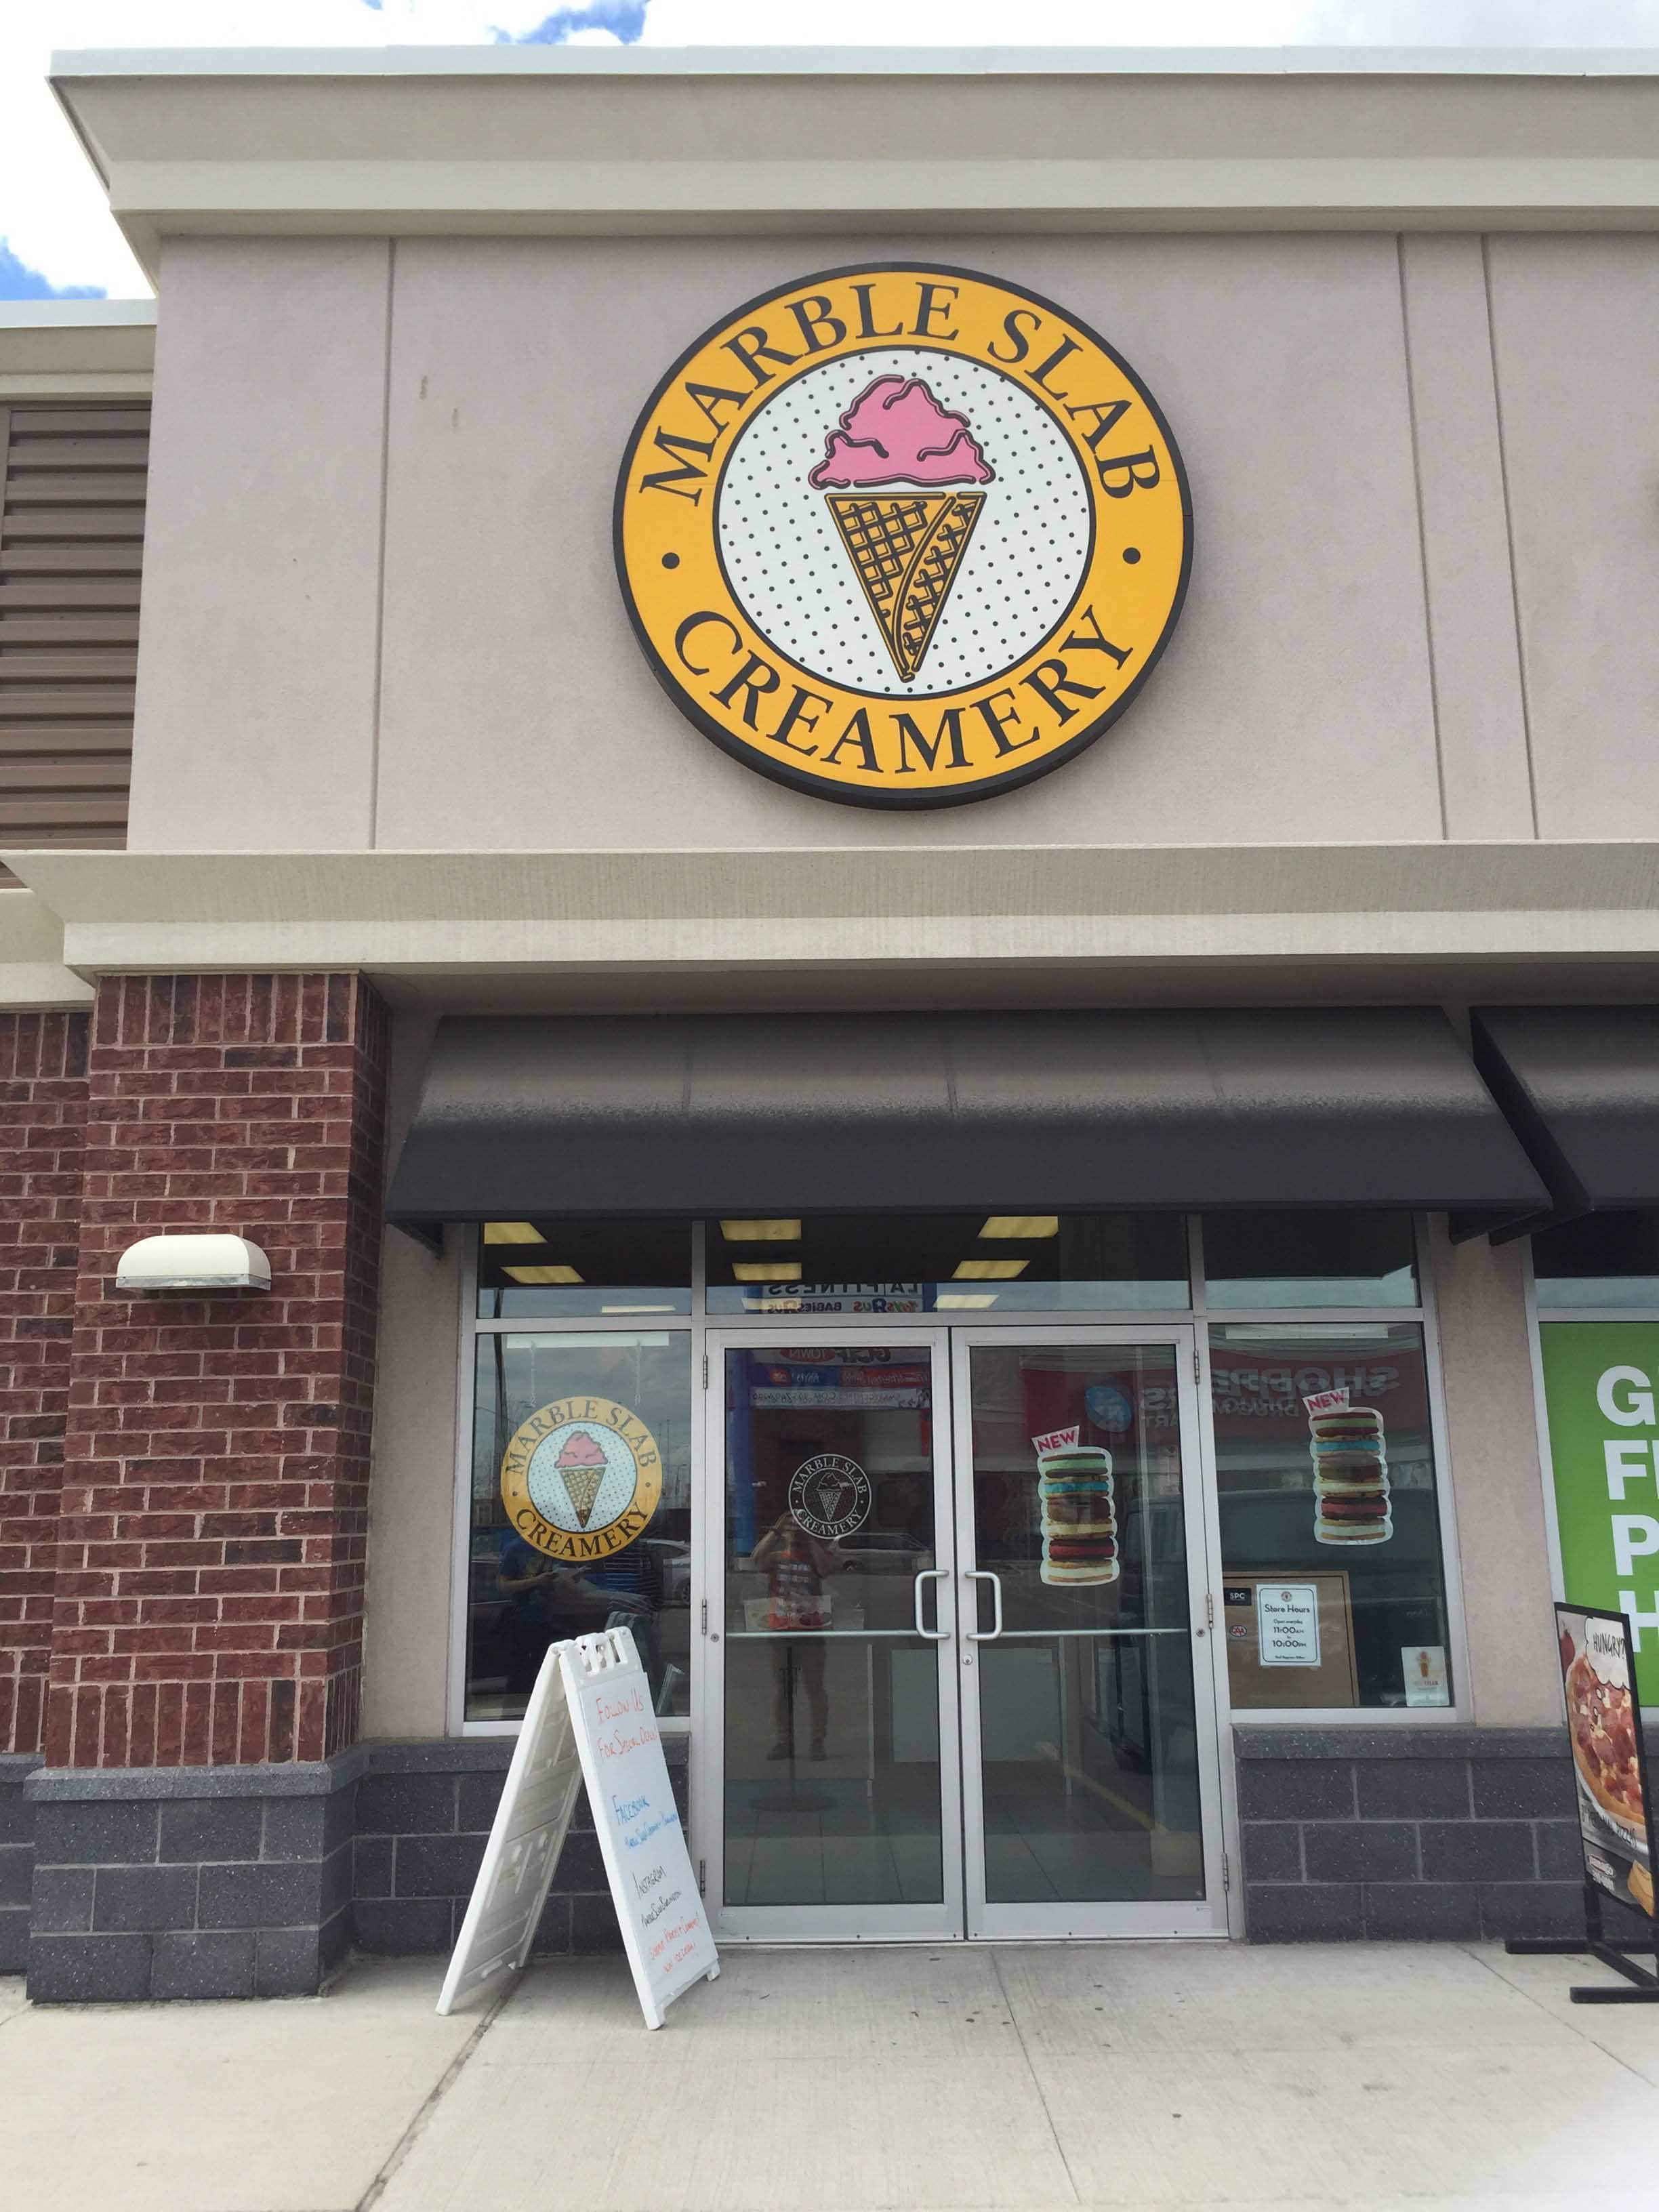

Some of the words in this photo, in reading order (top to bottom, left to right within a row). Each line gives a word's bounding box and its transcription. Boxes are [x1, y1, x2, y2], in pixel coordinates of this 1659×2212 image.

[638, 282, 960, 507] MARBLE
[987, 309, 1160, 499] SLAB
[674, 605, 1134, 774] CREAMERY
[1307, 1390, 1345, 1410] NEW
[506, 1399, 598, 1475] MARBLE
[607, 1407, 657, 1468] SLAB
[1037, 1430, 1075, 1452] NEW
[792, 1458, 839, 1493] MARBLE
[842, 1462, 867, 1493] SLAB
[516, 1502, 648, 1557] CREAMERY
[797, 1509, 861, 1535] CREAMERY
[1229, 1592, 1246, 1600] SPC
[1265, 1603, 1286, 1613] Store
[1287, 1604, 1310, 1613] Hours
[1593, 1632, 1626, 1660] HUNGRY?
